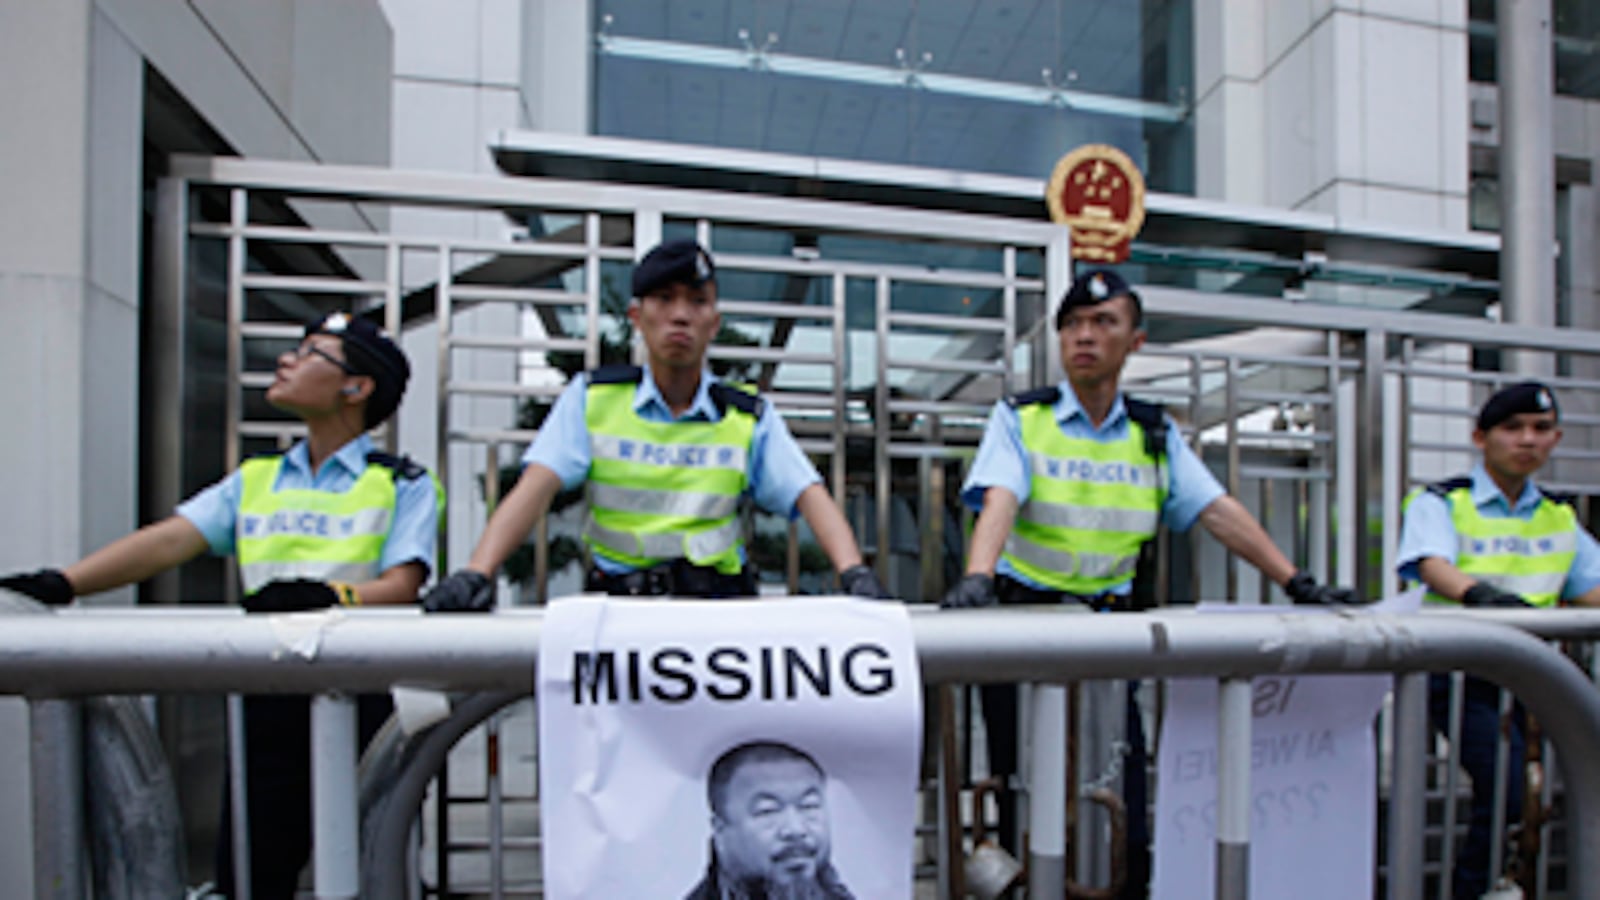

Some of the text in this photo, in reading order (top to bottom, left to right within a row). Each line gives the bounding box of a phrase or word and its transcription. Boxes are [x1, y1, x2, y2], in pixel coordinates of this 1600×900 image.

[641, 443, 708, 466] POLICE
[1066, 459, 1126, 482] POLICE
[572, 643, 896, 705] MISSING
